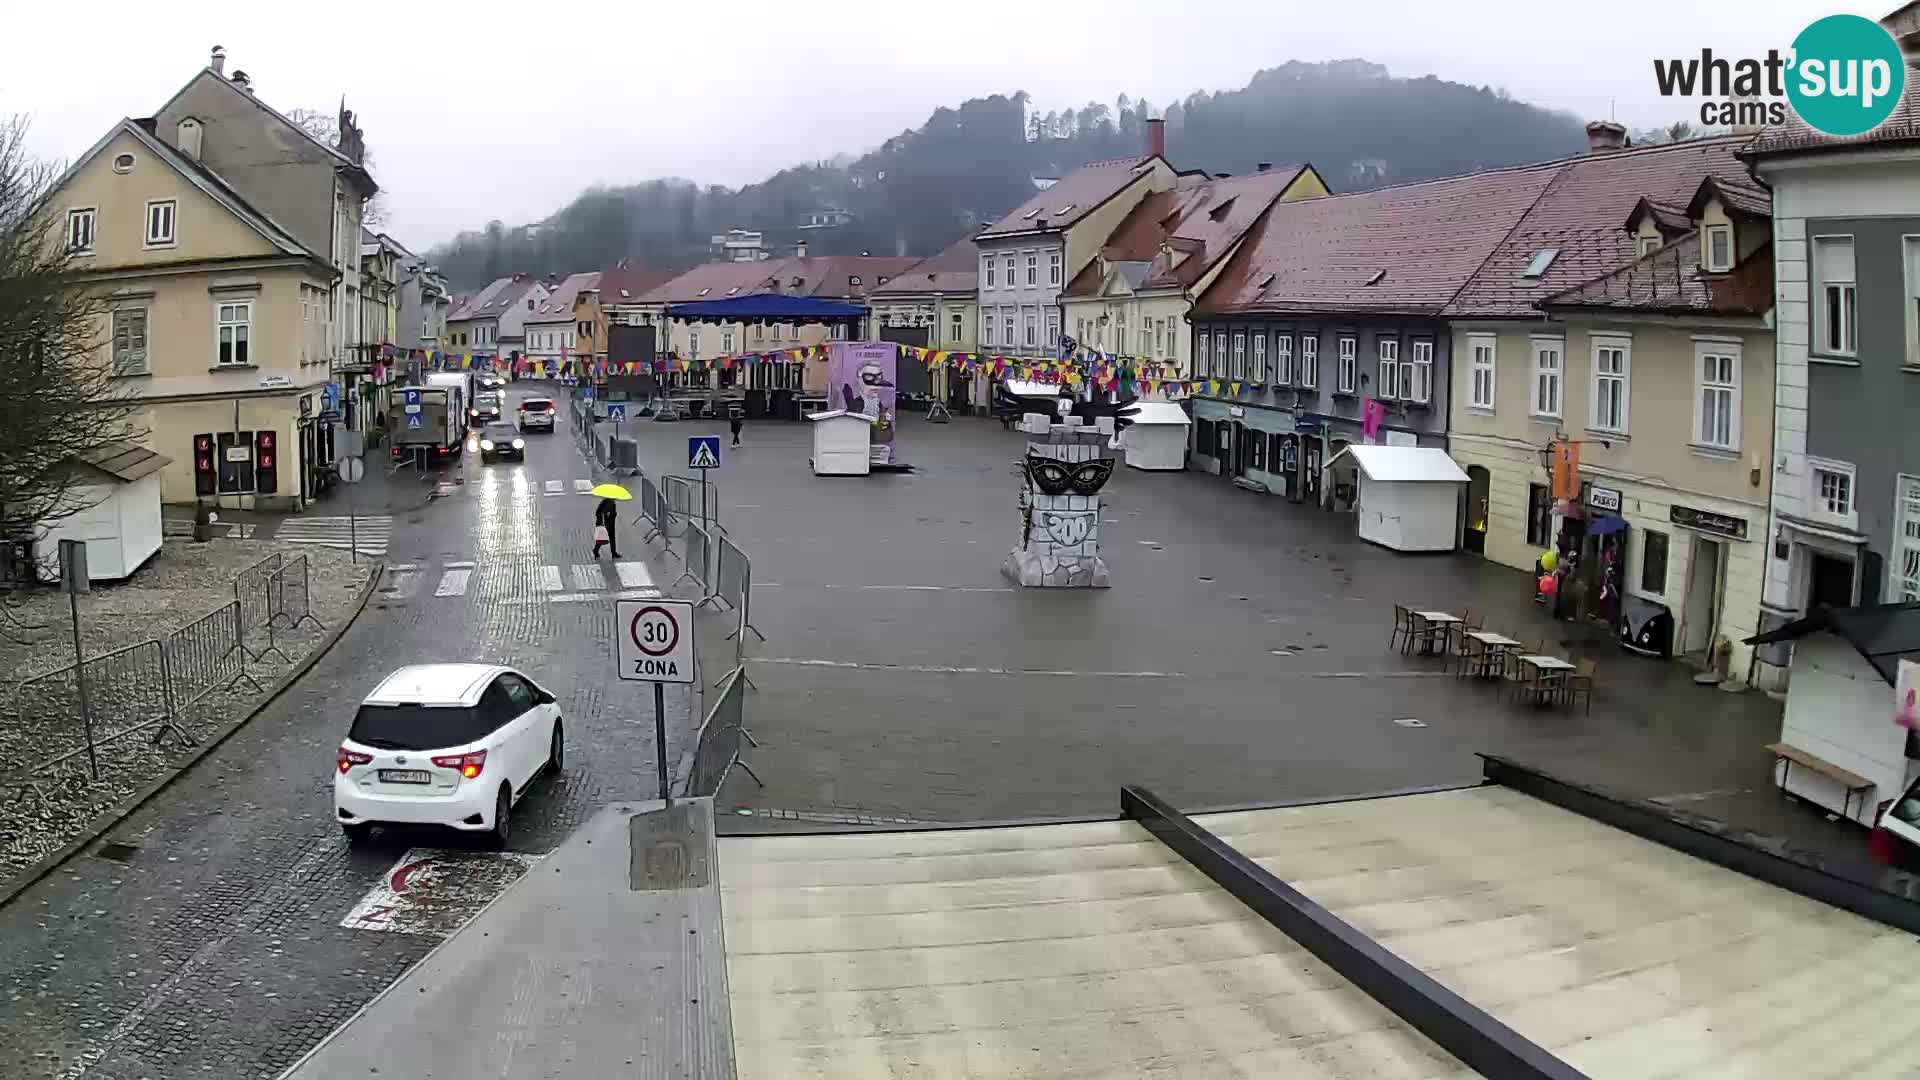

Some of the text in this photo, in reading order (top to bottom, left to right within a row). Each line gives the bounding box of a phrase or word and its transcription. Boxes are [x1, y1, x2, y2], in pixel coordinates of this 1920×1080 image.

[408, 391, 417, 403] P
[1047, 516, 1087, 545] 200
[644, 622, 667, 643] 30
[634, 659, 678, 676] ZONA
